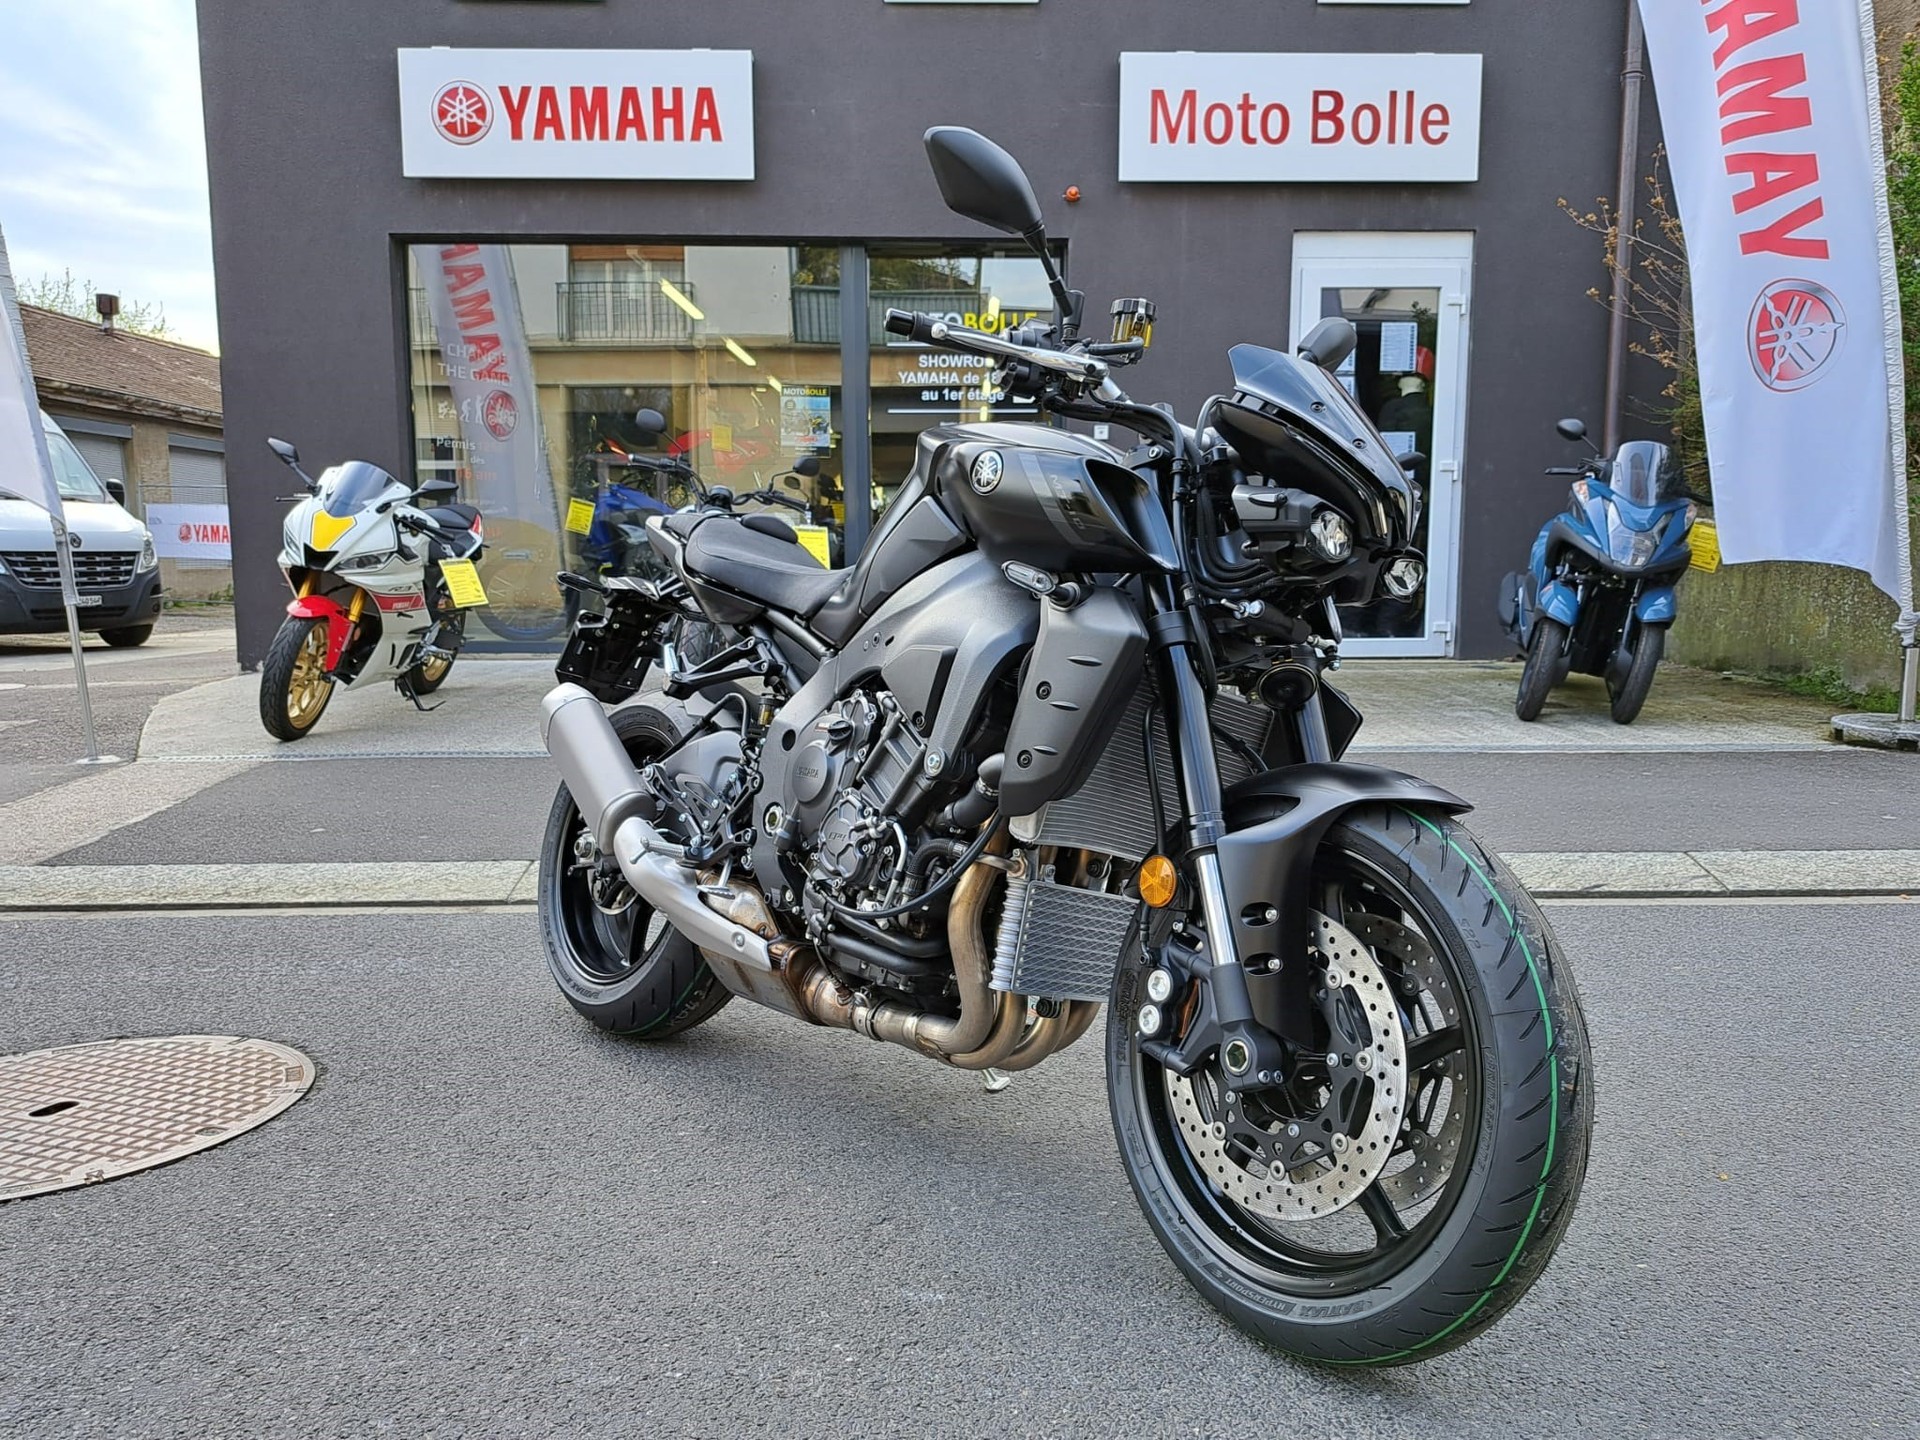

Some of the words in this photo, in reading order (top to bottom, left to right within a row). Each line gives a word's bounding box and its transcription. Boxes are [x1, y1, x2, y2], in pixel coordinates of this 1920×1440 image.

[498, 86, 723, 142] YAMAHA
[1149, 89, 1290, 145] Moto
[1310, 89, 1450, 145] Bolle
[447, 343, 507, 365] CHANGE
[918, 355, 994, 368] SHOWRO
[437, 362, 467, 379] THE
[470, 369, 512, 387] GAME
[898, 372, 960, 384] YAMAHA
[962, 372, 980, 384] de
[783, 387, 827, 396] MOTOBOLLE
[921, 390, 939, 401] au
[941, 388, 964, 401] 1er
[967, 388, 1005, 403] étage
[436, 435, 476, 450] Permis
[193, 525, 231, 543] YAMA
[1225, 1278, 1287, 1311] HYPERSPORT
